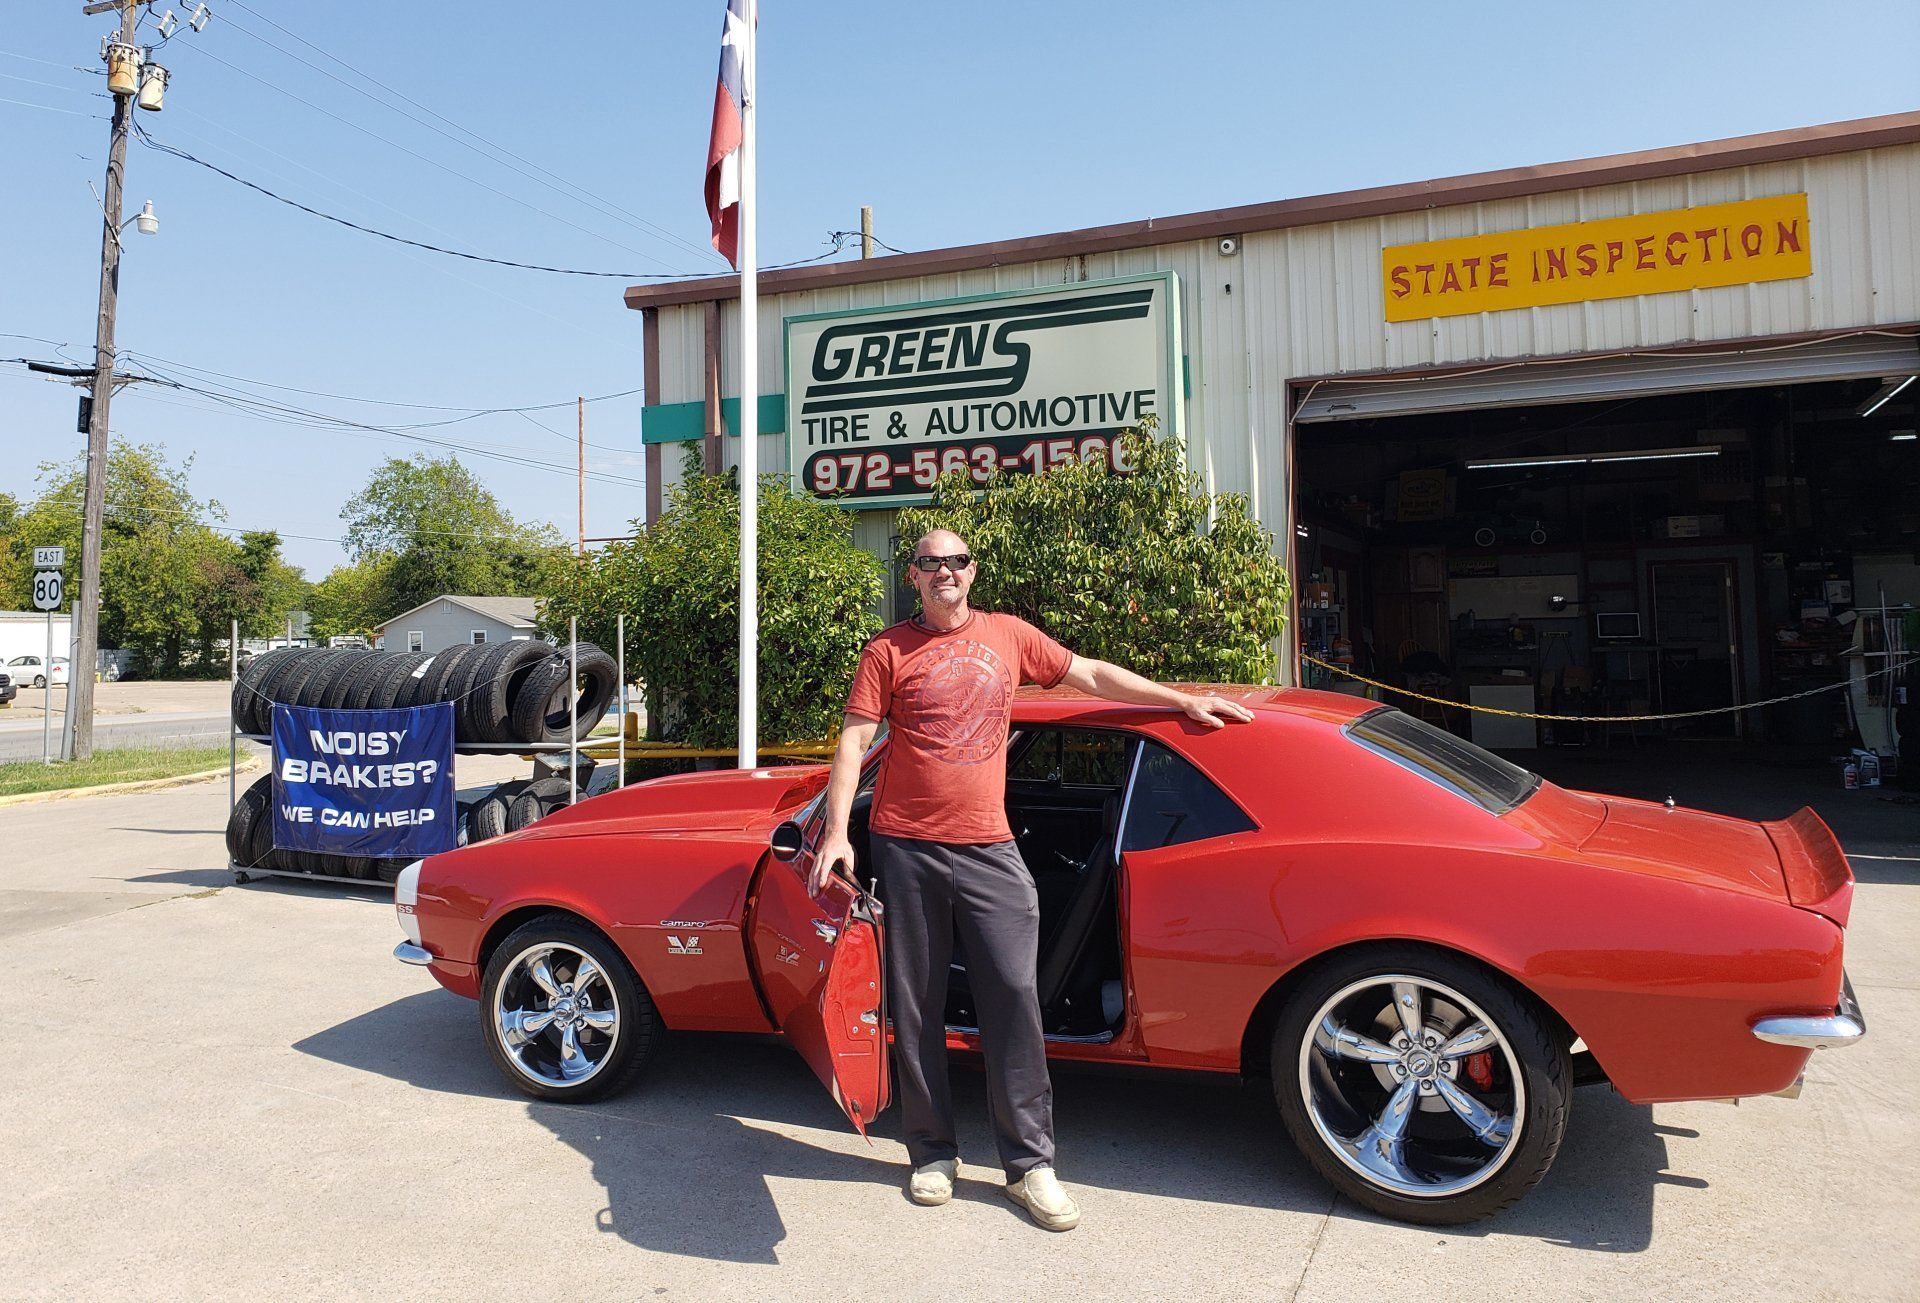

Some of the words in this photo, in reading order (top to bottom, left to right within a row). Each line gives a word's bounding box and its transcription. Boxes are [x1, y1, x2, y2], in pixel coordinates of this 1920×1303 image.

[1390, 253, 1510, 298] STATE
[1532, 219, 1802, 283] INSPECTION
[801, 414, 870, 446] TIRE
[886, 411, 908, 440] &
[924, 389, 1157, 437] AUTOMOTIVE
[38, 551, 60, 563] EAST
[36, 578, 60, 602] 80
[309, 729, 408, 756] NOISY
[281, 758, 439, 789] BRAKES?
[281, 804, 313, 824] WE
[320, 808, 370, 829] CAN
[374, 808, 435, 829] HELP
